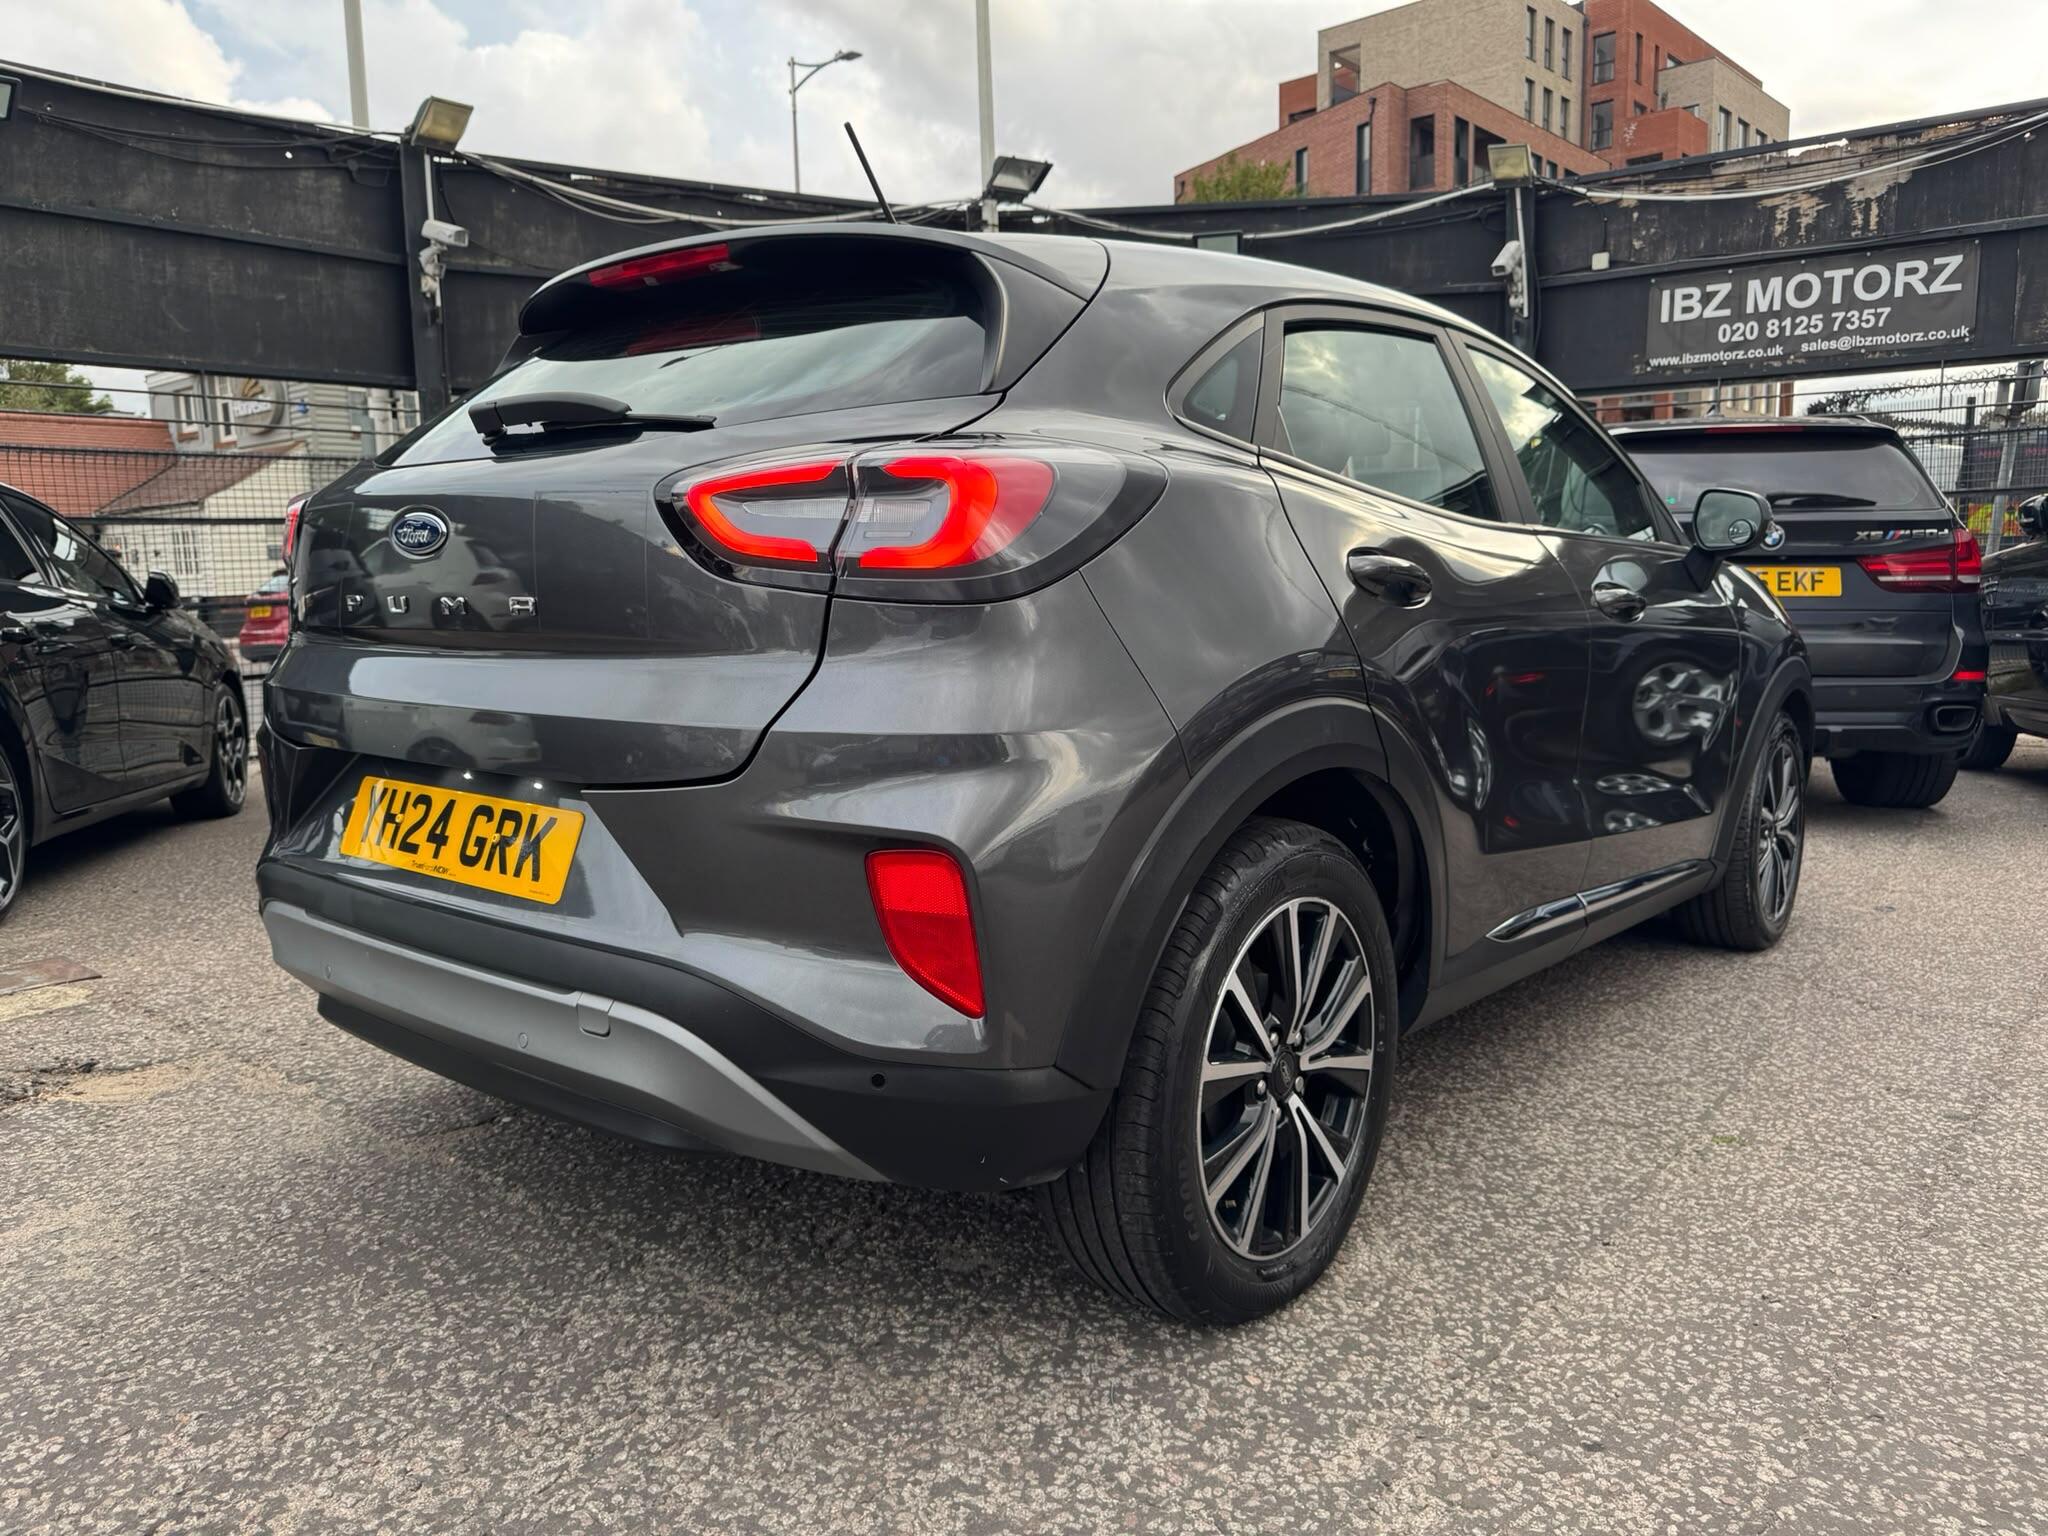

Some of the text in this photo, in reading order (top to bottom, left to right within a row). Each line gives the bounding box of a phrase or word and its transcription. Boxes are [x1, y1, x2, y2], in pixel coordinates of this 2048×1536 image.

[1660, 254, 1964, 323] IBZ MOTORZ
[1717, 307, 1891, 344] 020 8125 7357
[1649, 325, 1970, 368] www.ibzmotorz.co.uk sales@ibzmotorz.co.uk
[396, 520, 431, 544] Ford
[1776, 571, 1825, 592] EKF
[345, 594, 537, 617] PUMA
[361, 784, 558, 883] YH24 GRK
